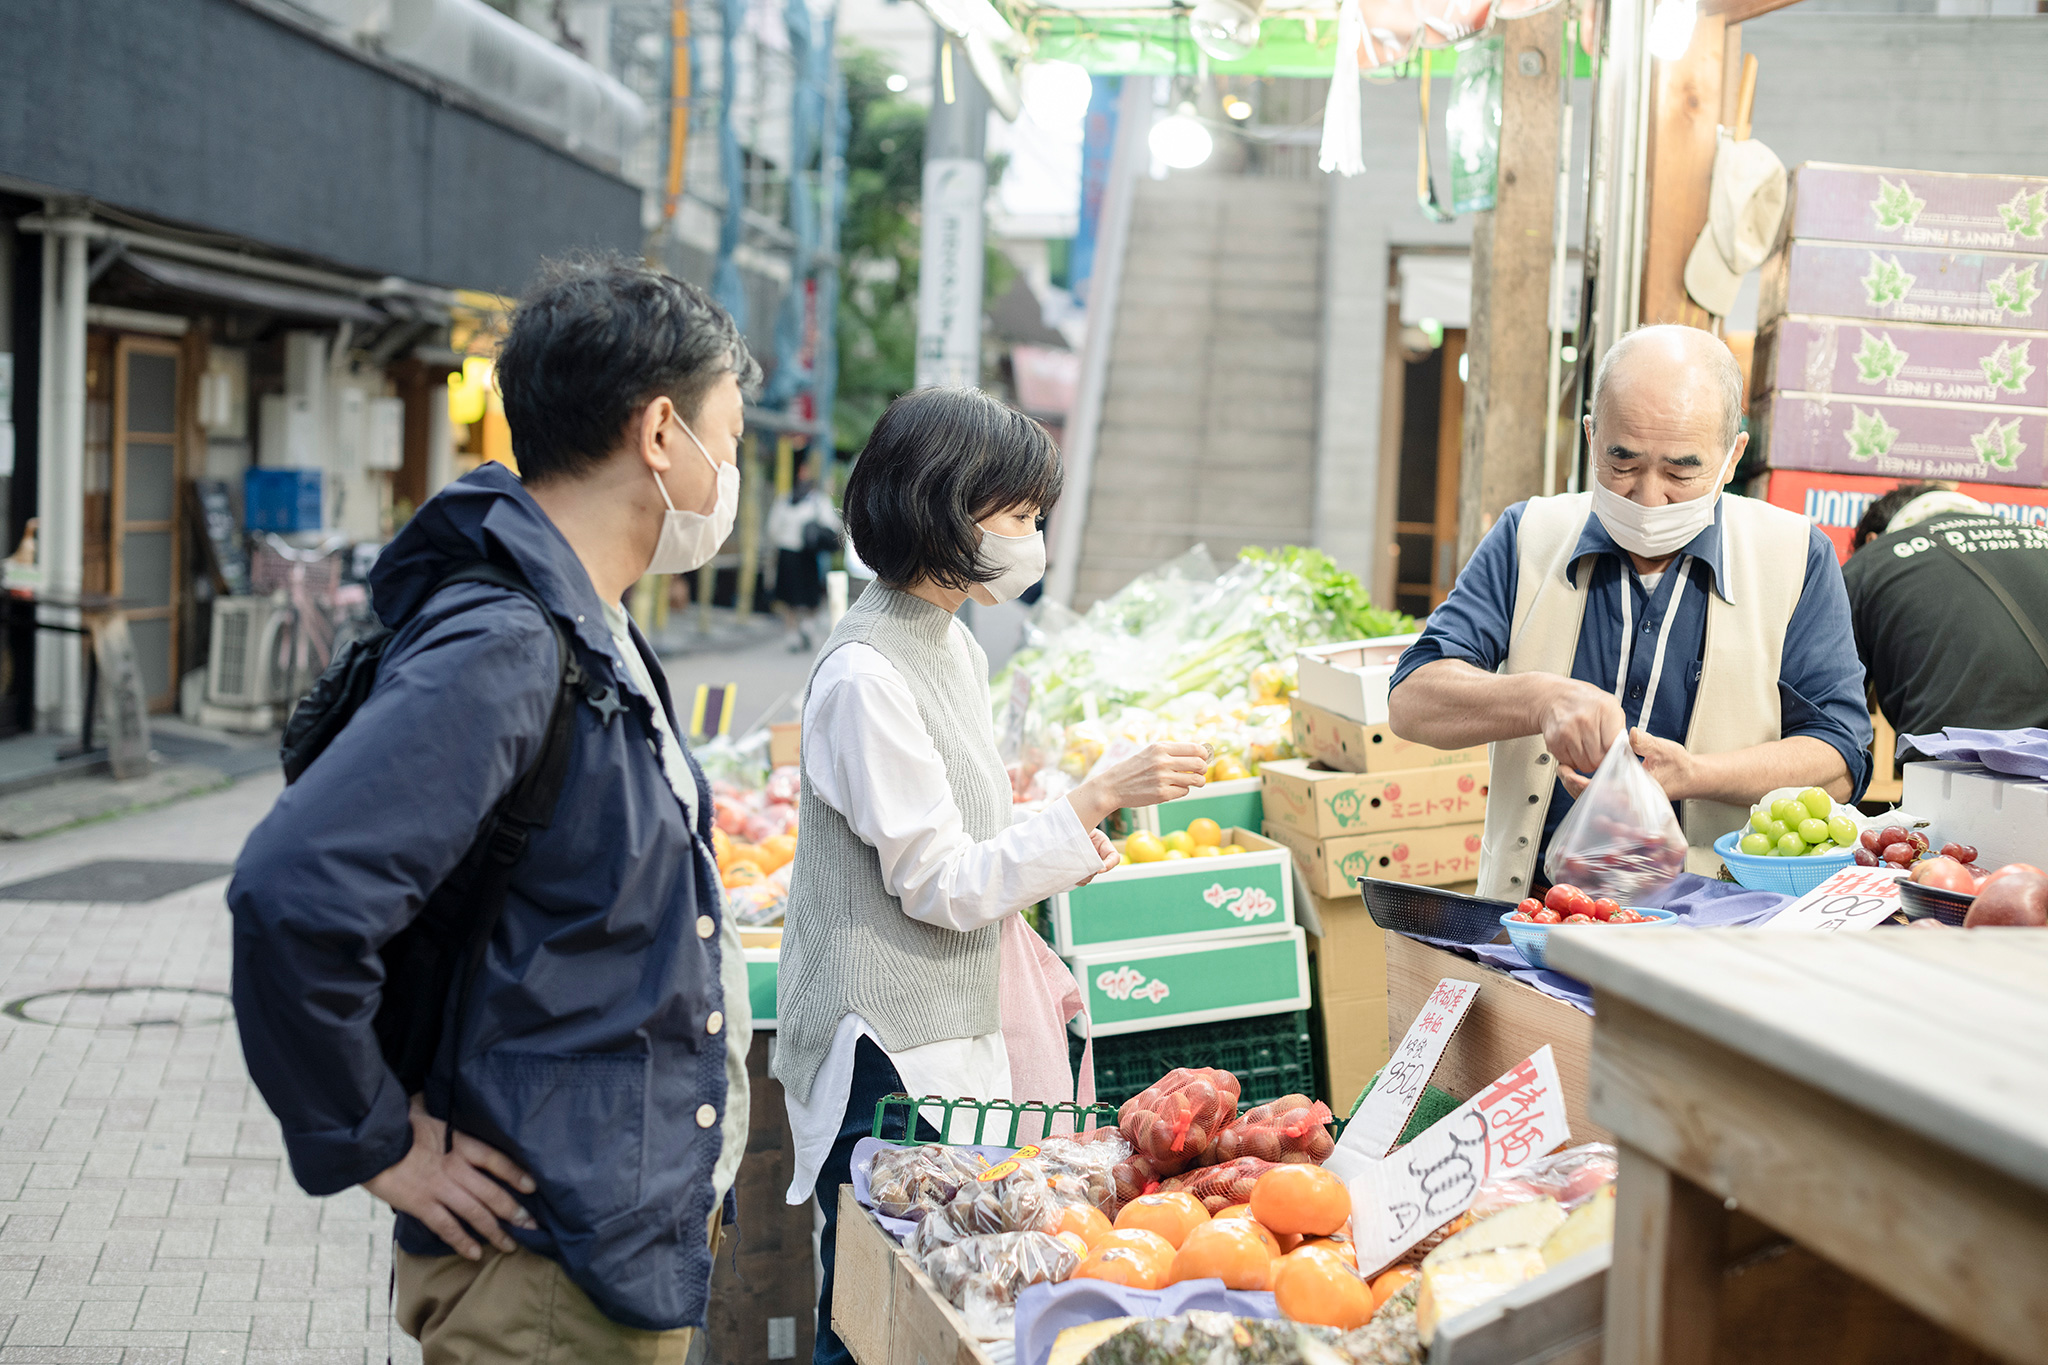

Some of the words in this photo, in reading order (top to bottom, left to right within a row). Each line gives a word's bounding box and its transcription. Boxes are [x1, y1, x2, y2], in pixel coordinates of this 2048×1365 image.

[1903, 226, 1948, 244] FINEST
[1894, 302, 1937, 319] FINEST
[1886, 379, 1930, 396] FINEST
[1876, 457, 1922, 474] FINEST
[1893, 531, 1966, 558] GOD
[1391, 796, 1470, 819] ミニトマト
[1399, 856, 1476, 879] ミニトマト
[1799, 895, 1885, 917] 100
[1419, 1011, 1444, 1034] 特価
[1478, 1058, 1546, 1168] 特価
